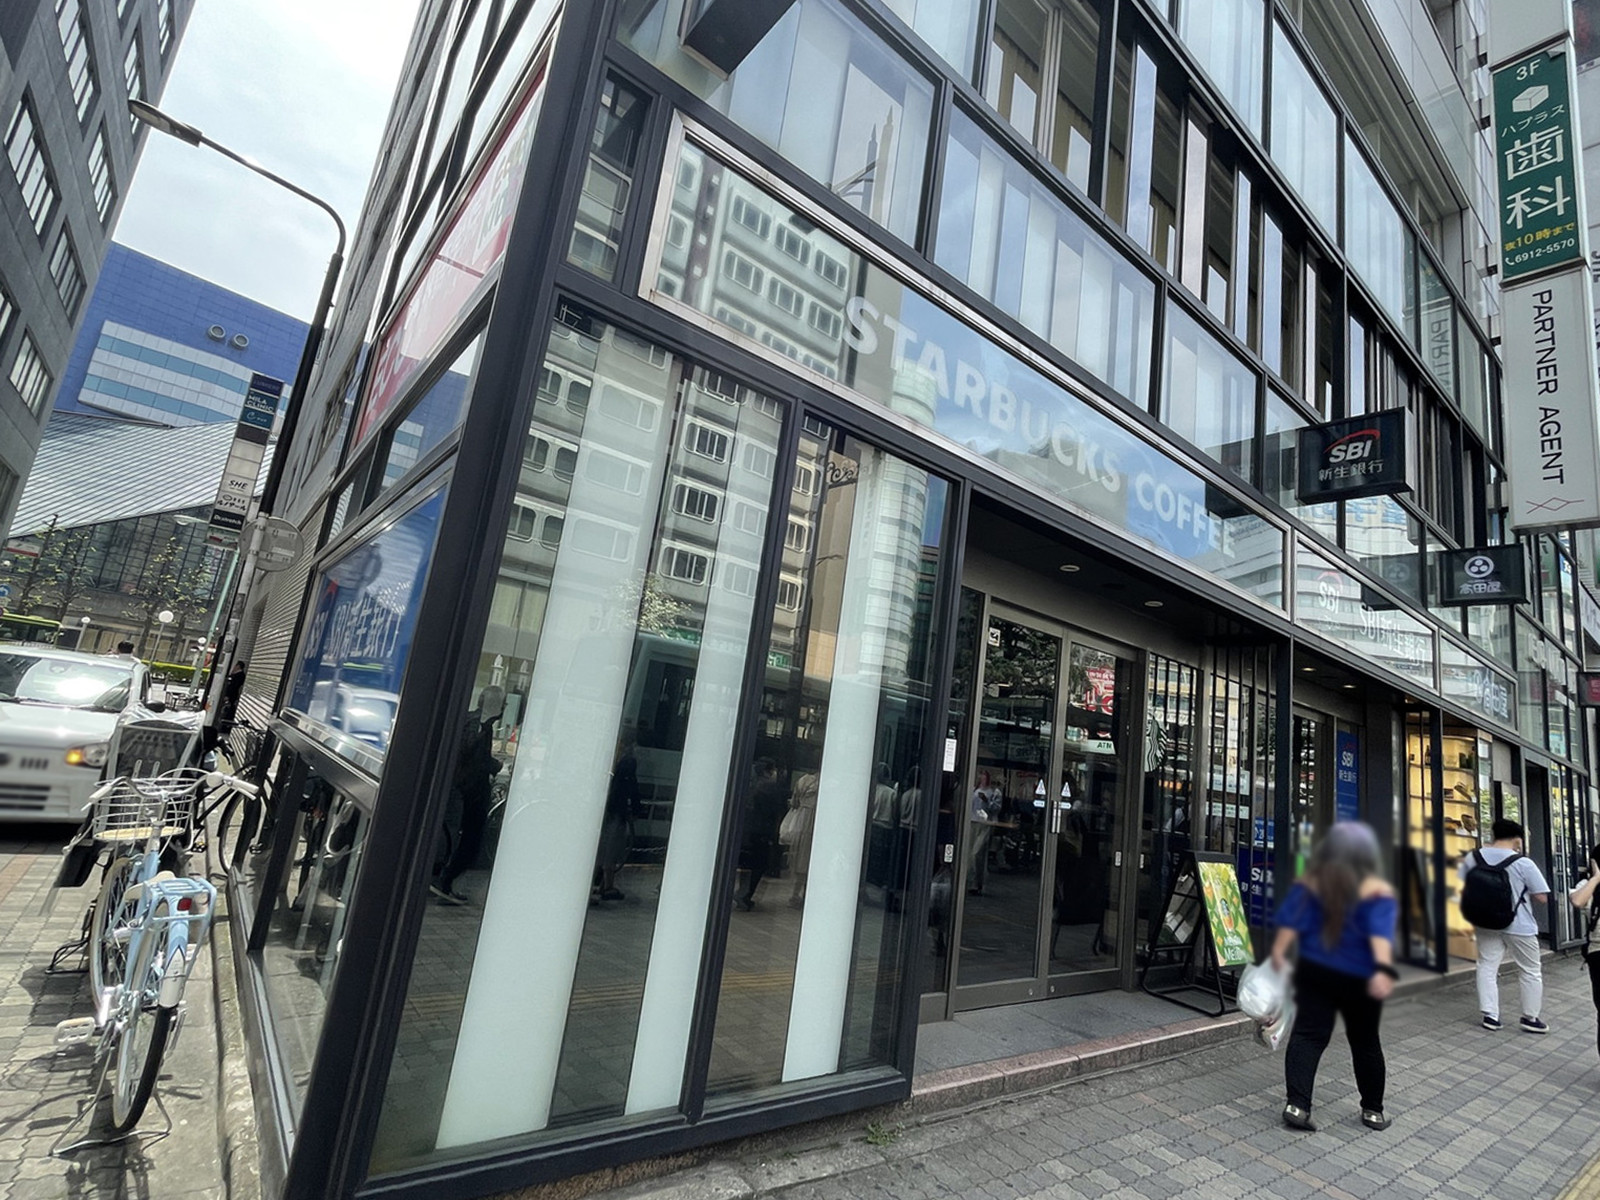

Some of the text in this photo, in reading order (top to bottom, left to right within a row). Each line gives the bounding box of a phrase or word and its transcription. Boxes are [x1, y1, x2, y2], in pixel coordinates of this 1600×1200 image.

[1516, 58, 1542, 81] 3F
[1504, 125, 1571, 230] 歯科
[1514, 237, 1575, 265] 6912-5570
[1532, 288, 1564, 484] PARTNER AGENT
[842, 295, 1236, 559] STARBUCKS COFFEE
[1328, 439, 1373, 463] SBI
[1318, 459, 1384, 482] 新生銀行
